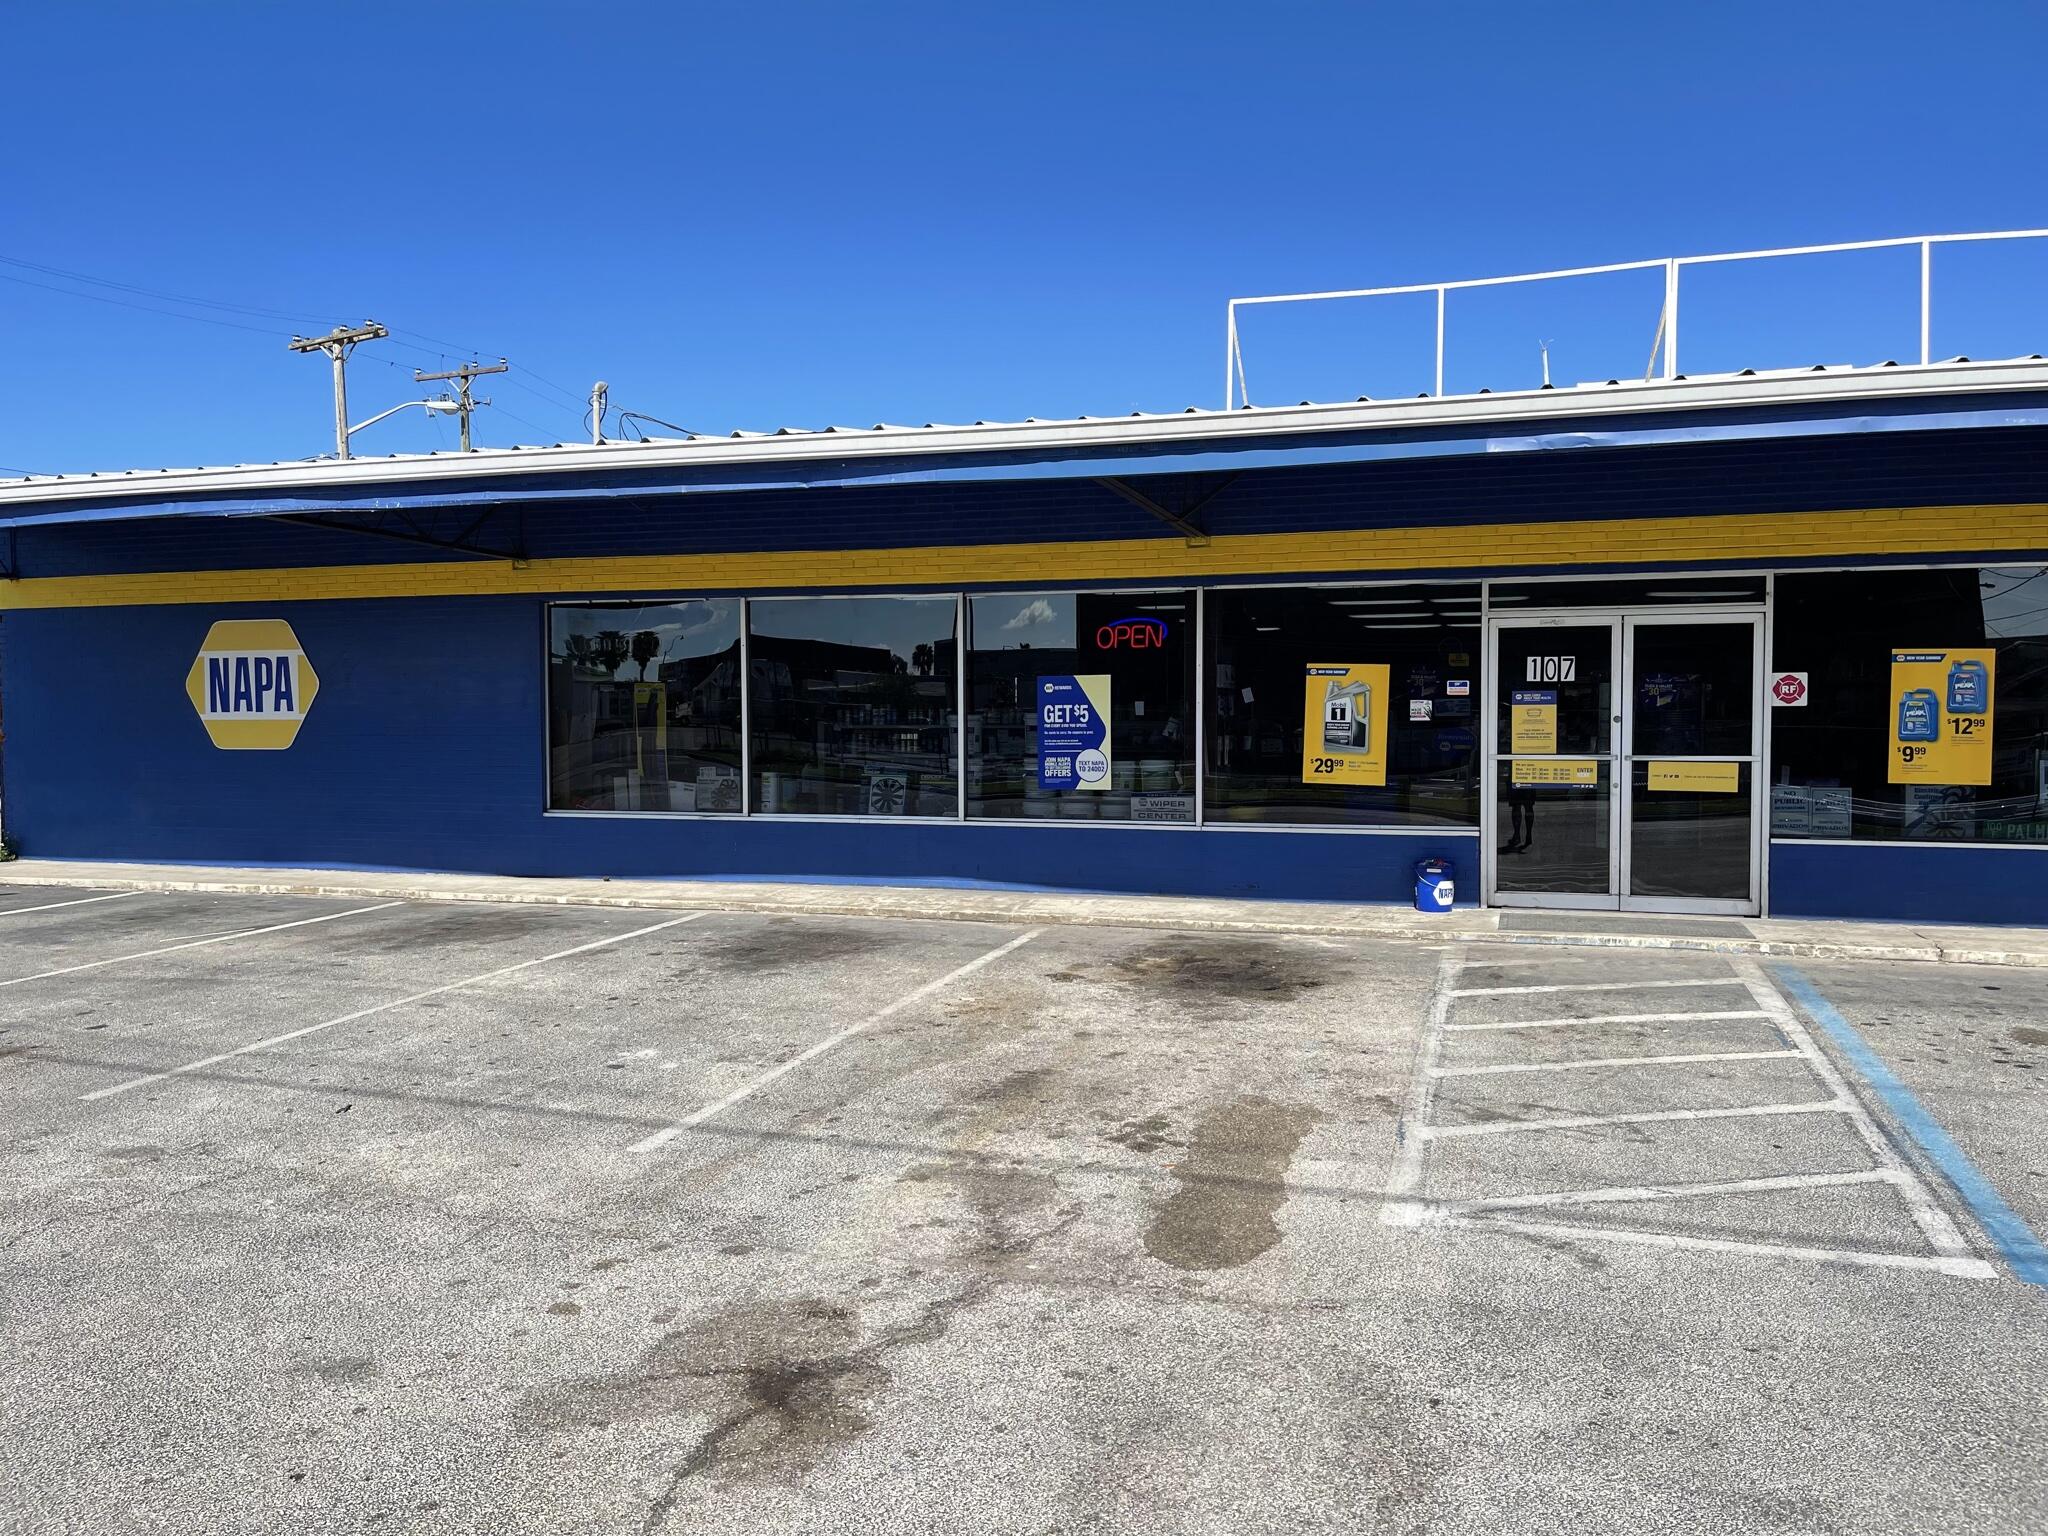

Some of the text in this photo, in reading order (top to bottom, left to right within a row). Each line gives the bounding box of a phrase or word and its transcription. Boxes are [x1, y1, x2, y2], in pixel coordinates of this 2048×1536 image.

[1097, 625, 1163, 649] OPEN
[1530, 656, 1575, 681] 107
[209, 656, 294, 713] NAPA
[1780, 684, 1797, 694] RF
[1044, 704, 1089, 723] GET $5
[1044, 769, 1072, 777] OFFERS
[1138, 812, 1186, 820] CENTER
